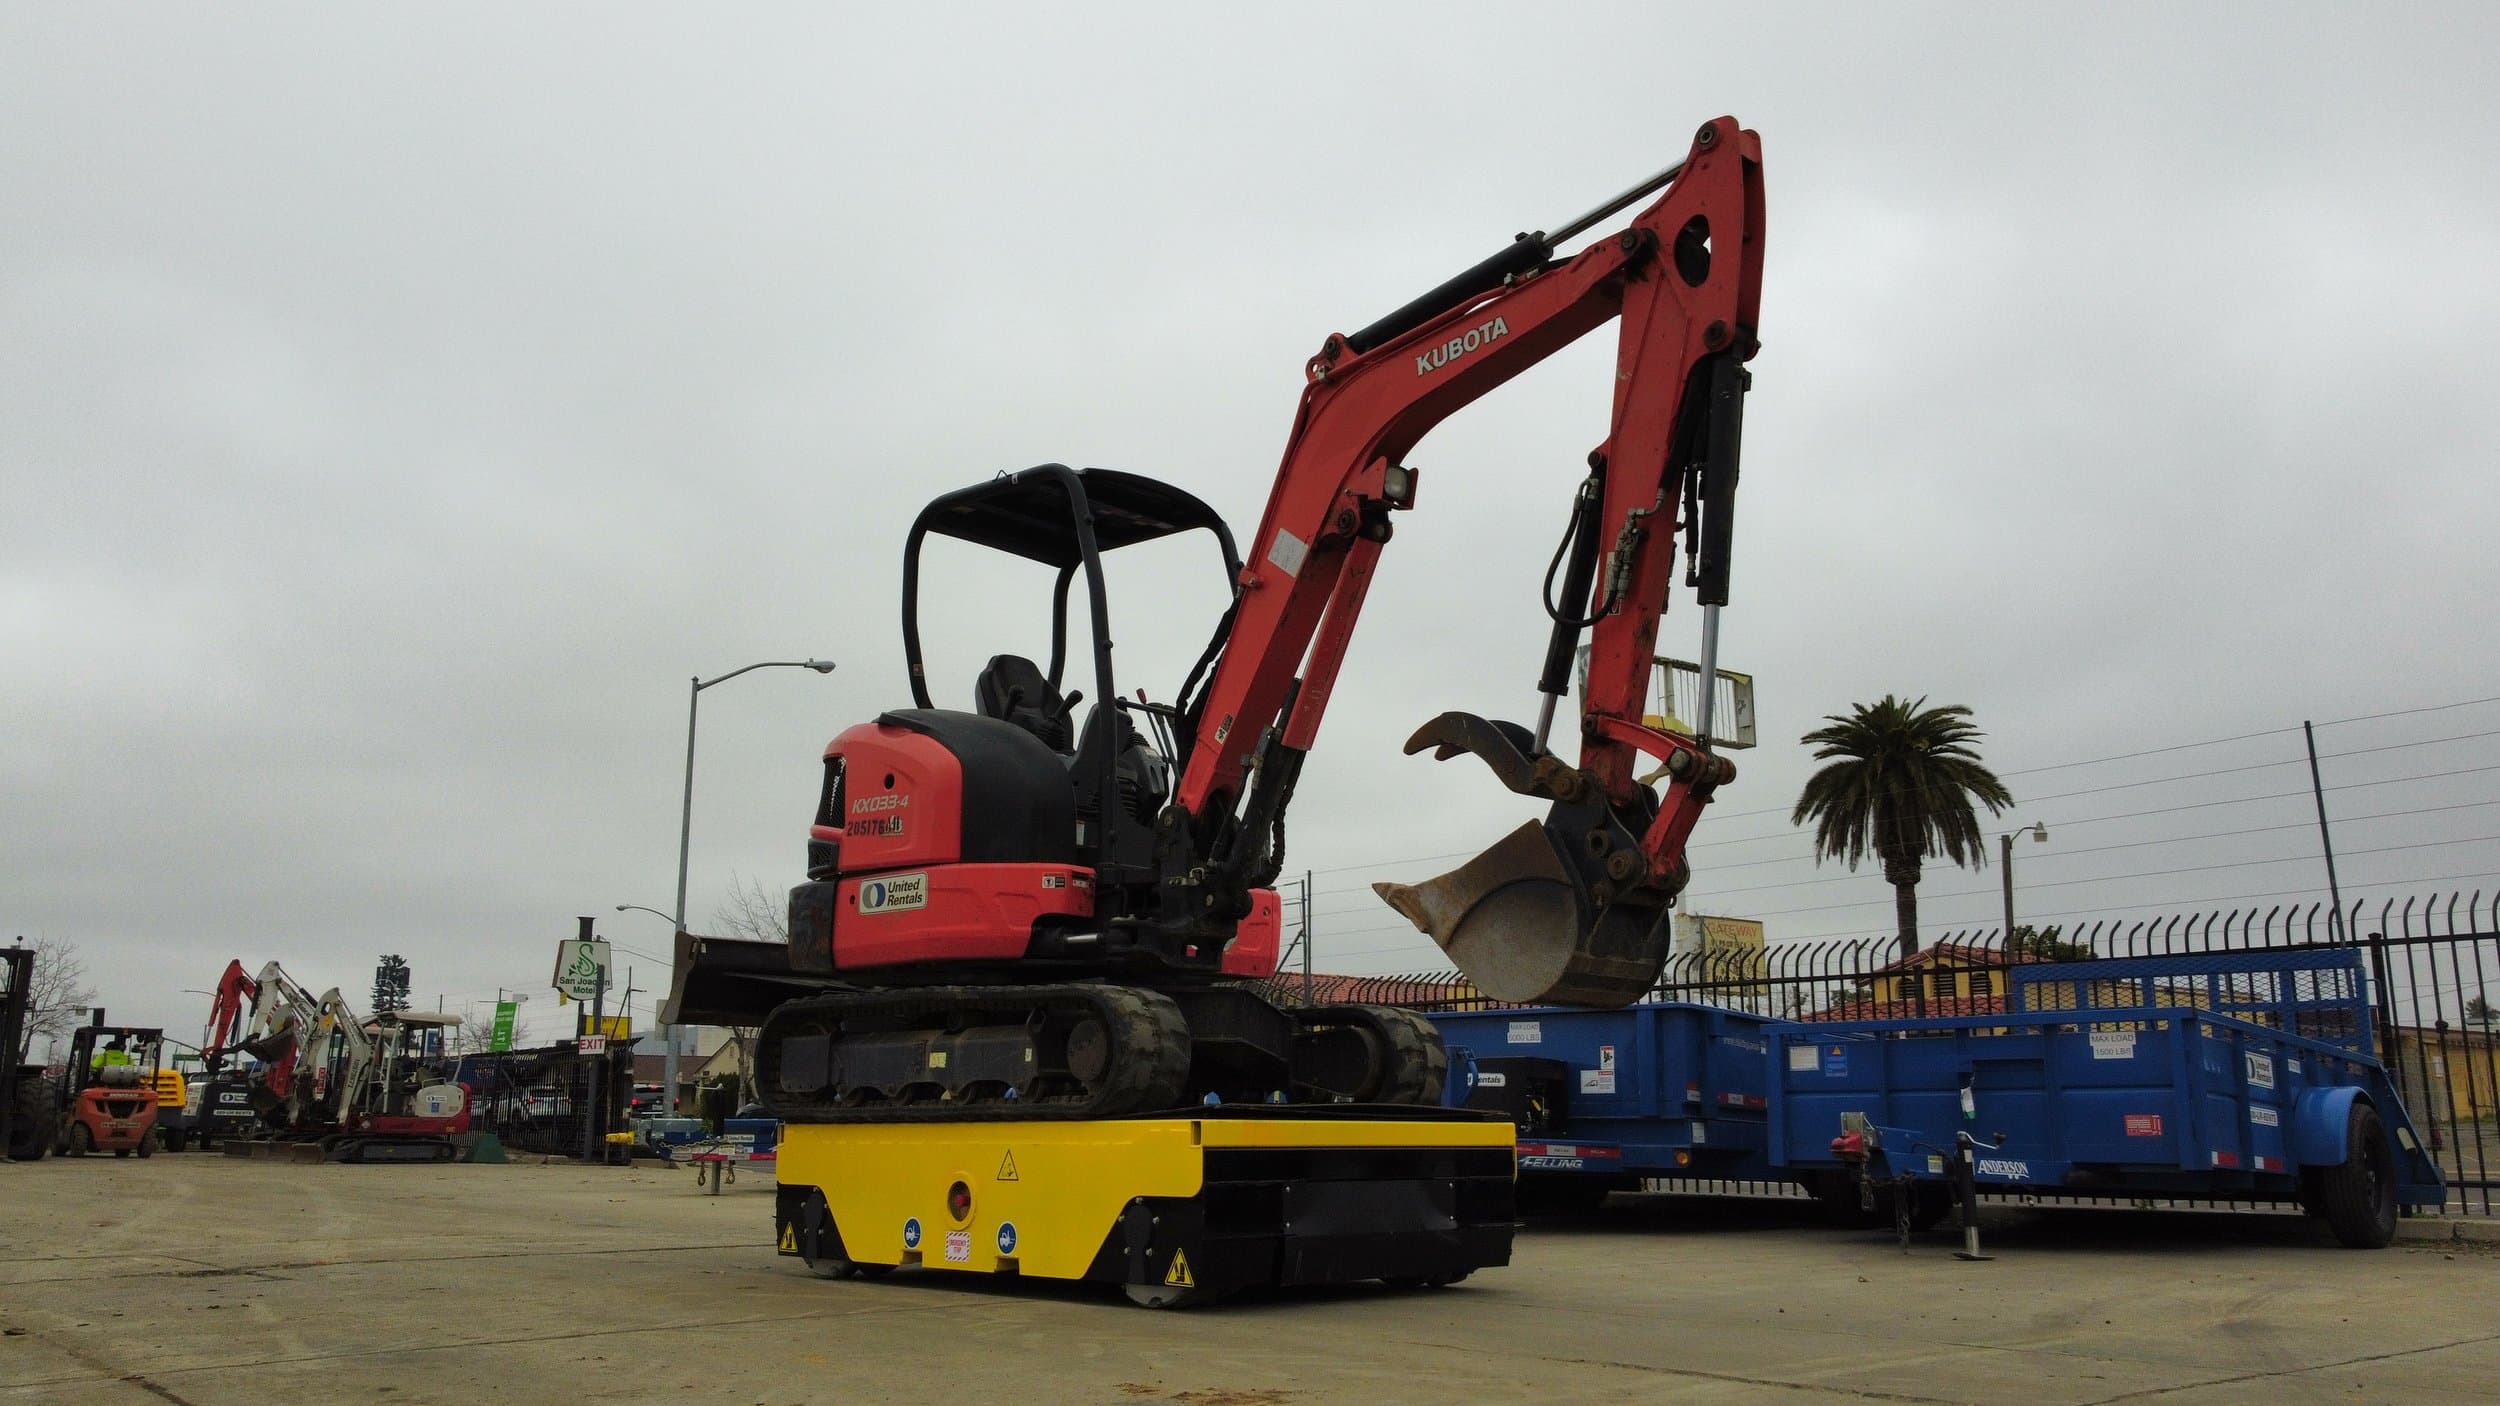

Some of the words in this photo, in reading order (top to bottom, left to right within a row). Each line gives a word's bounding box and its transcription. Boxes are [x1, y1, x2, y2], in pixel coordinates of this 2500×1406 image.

[1414, 314, 1510, 377] KUBOTA
[852, 794, 909, 814] KX033-4
[887, 877, 921, 894] United
[886, 891, 923, 907] Rentals
[559, 976, 576, 985] San
[577, 977, 611, 986] Joaqn
[573, 986, 596, 994] Motel
[579, 1038, 605, 1050] EXIT
[2091, 1033, 2110, 1043] MAX
[2110, 1033, 2134, 1043] LOAD
[2095, 1047, 2114, 1056] 1500
[2115, 1047, 2132, 1056] LBS
[1478, 1075, 1501, 1084] entals
[1517, 1156, 1584, 1169] FELLING
[1977, 1159, 2030, 1176] ANDERSON
